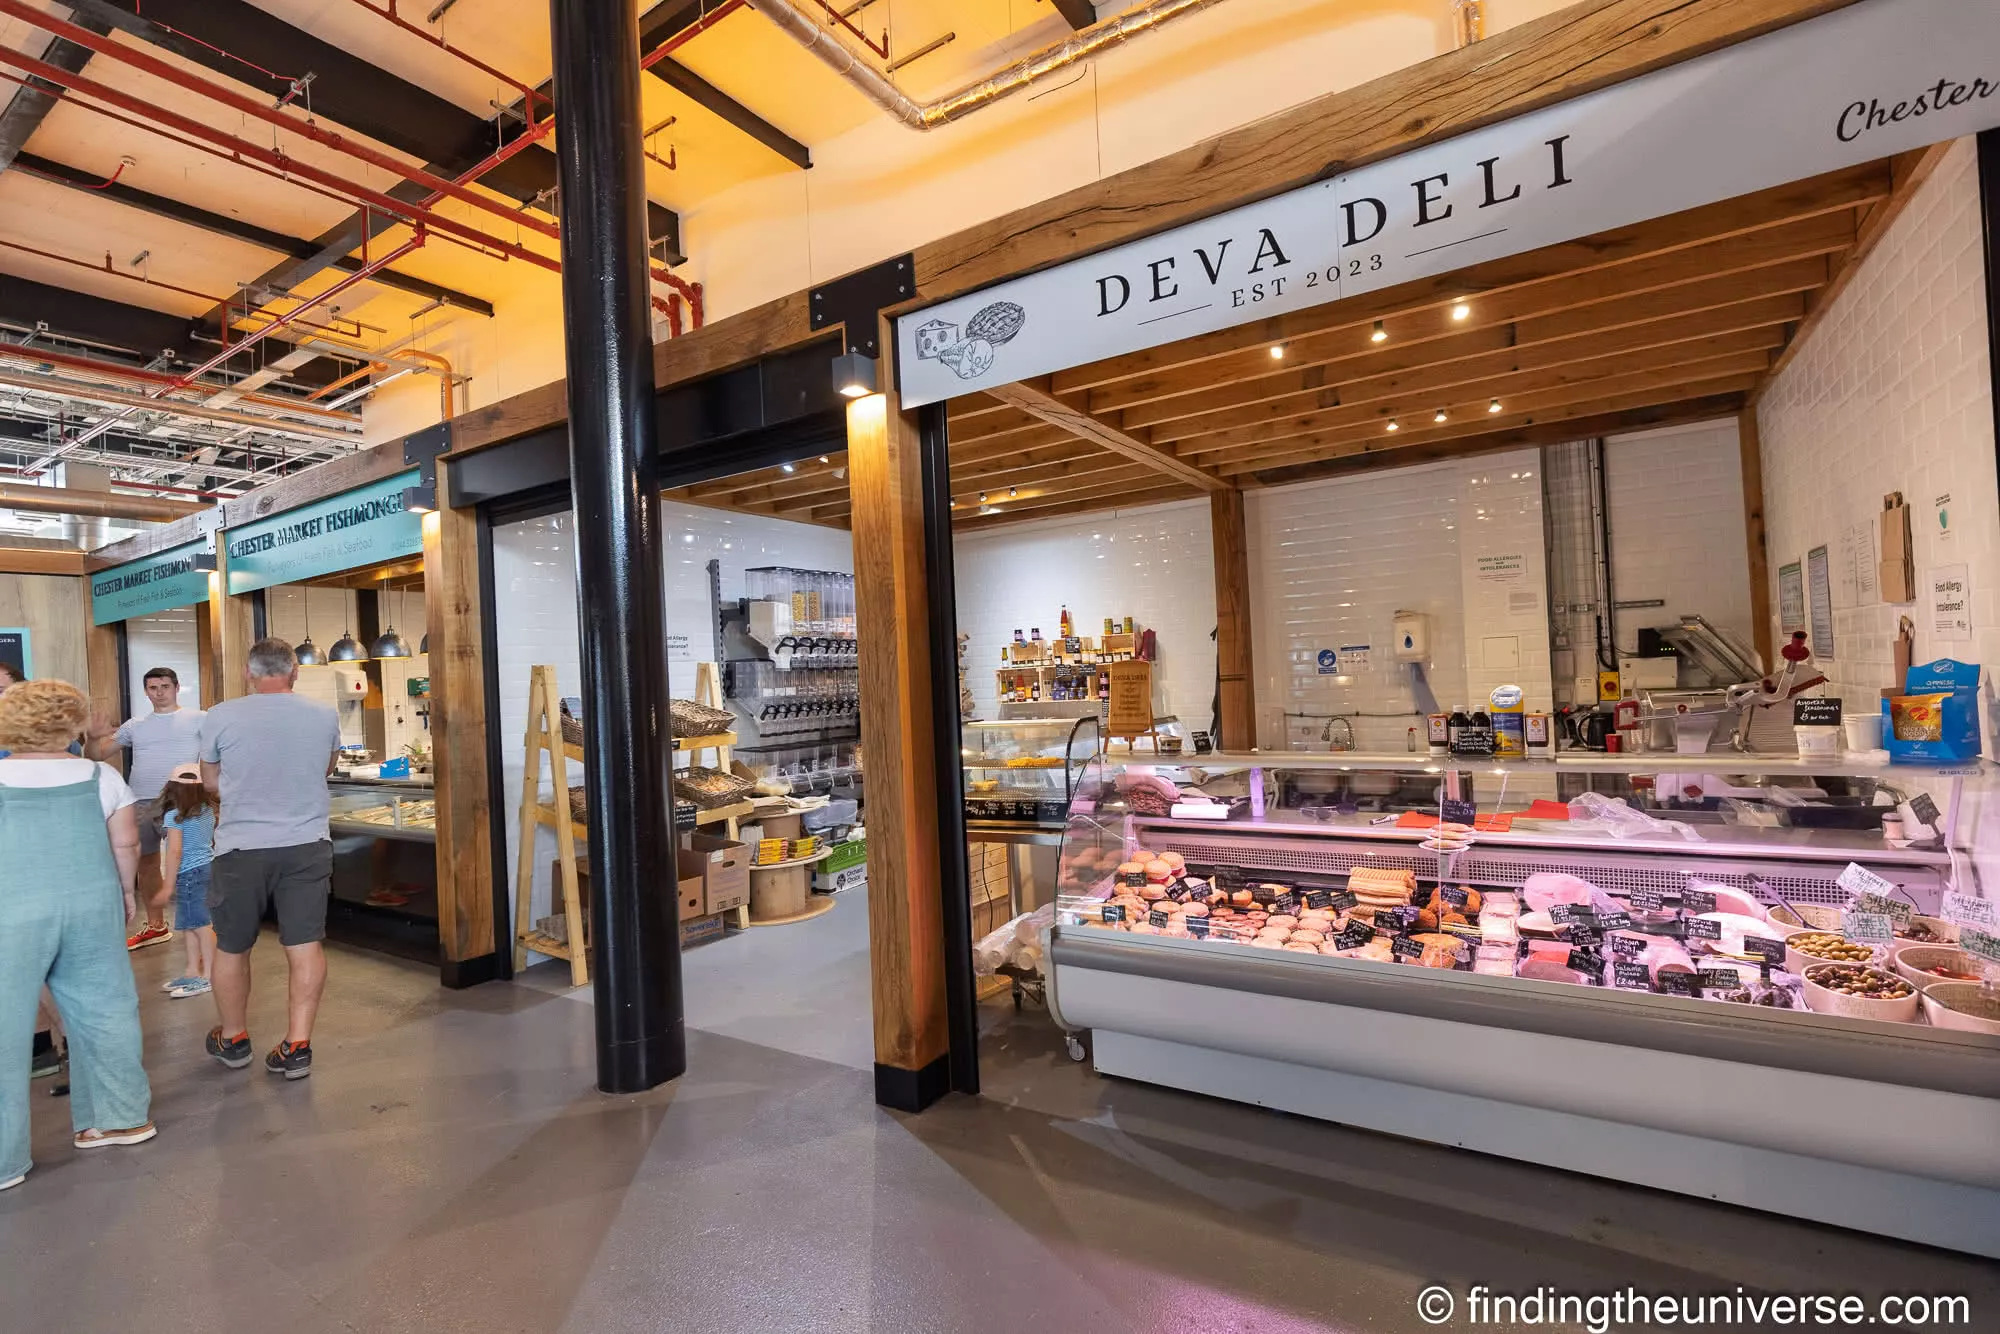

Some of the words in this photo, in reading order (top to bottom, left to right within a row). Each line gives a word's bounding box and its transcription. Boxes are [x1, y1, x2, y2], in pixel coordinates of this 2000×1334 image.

[1836, 77, 2000, 142] Chester
[1095, 227, 1292, 318] DEVA
[1340, 134, 1572, 248] DELI
[1230, 277, 1288, 308] EST
[1305, 254, 1384, 288] 2023
[229, 532, 277, 559] CHESTER
[277, 517, 324, 547] MARKET
[94, 578, 124, 598] CHESTER
[124, 568, 153, 590] MARKET
[1935, 583, 1946, 592] Food
[1946, 581, 1962, 592] Allergy
[1936, 600, 1964, 612] Intolerance?
[846, 866, 864, 877] Orchard
[846, 875, 861, 885] Choice
[1864, 892, 1911, 914] SILVER
